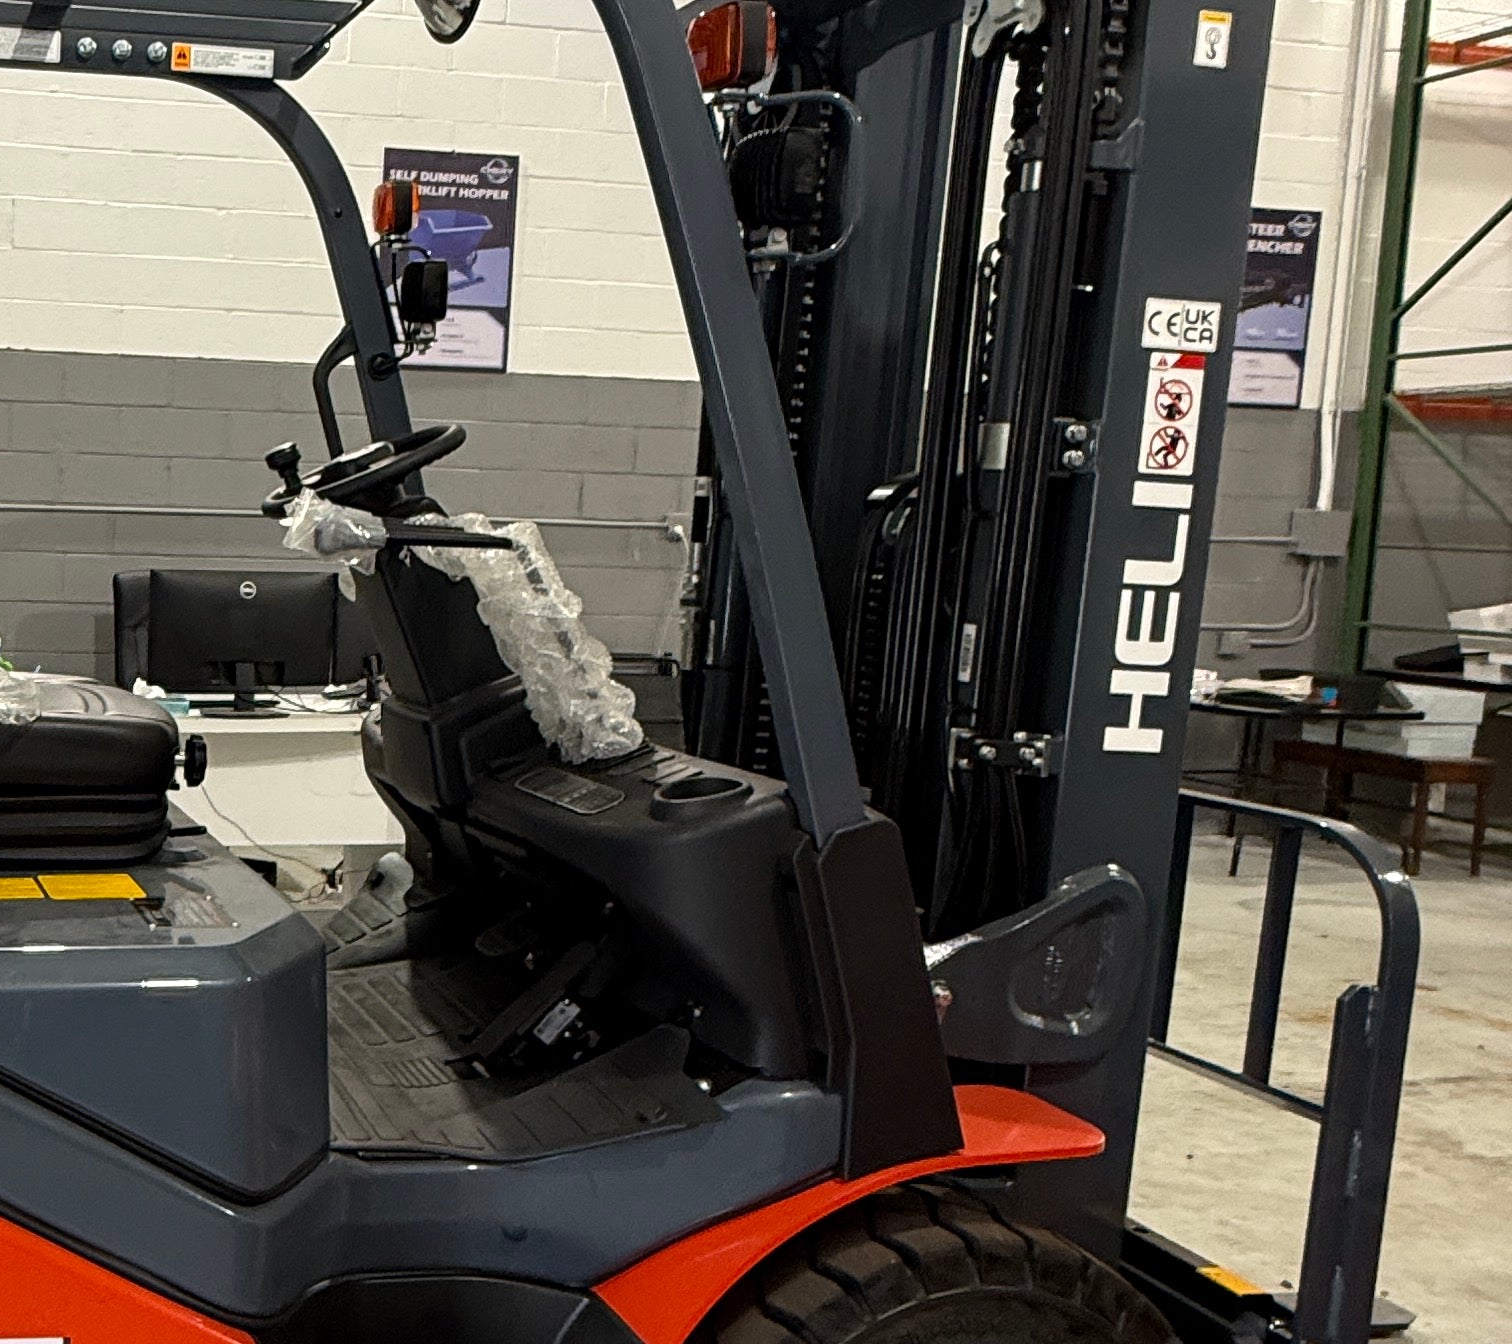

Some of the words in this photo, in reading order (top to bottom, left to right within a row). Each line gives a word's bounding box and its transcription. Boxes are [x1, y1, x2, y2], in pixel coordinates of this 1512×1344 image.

[389, 169, 419, 181] SELF
[420, 171, 479, 185] DUMPING
[458, 188, 509, 200] HOPPER
[1247, 239, 1304, 254] ENCHER
[1148, 310, 1181, 337] CE
[1185, 308, 1215, 326] UK
[1183, 327, 1214, 344] CA
[1102, 480, 1194, 754] HELI
